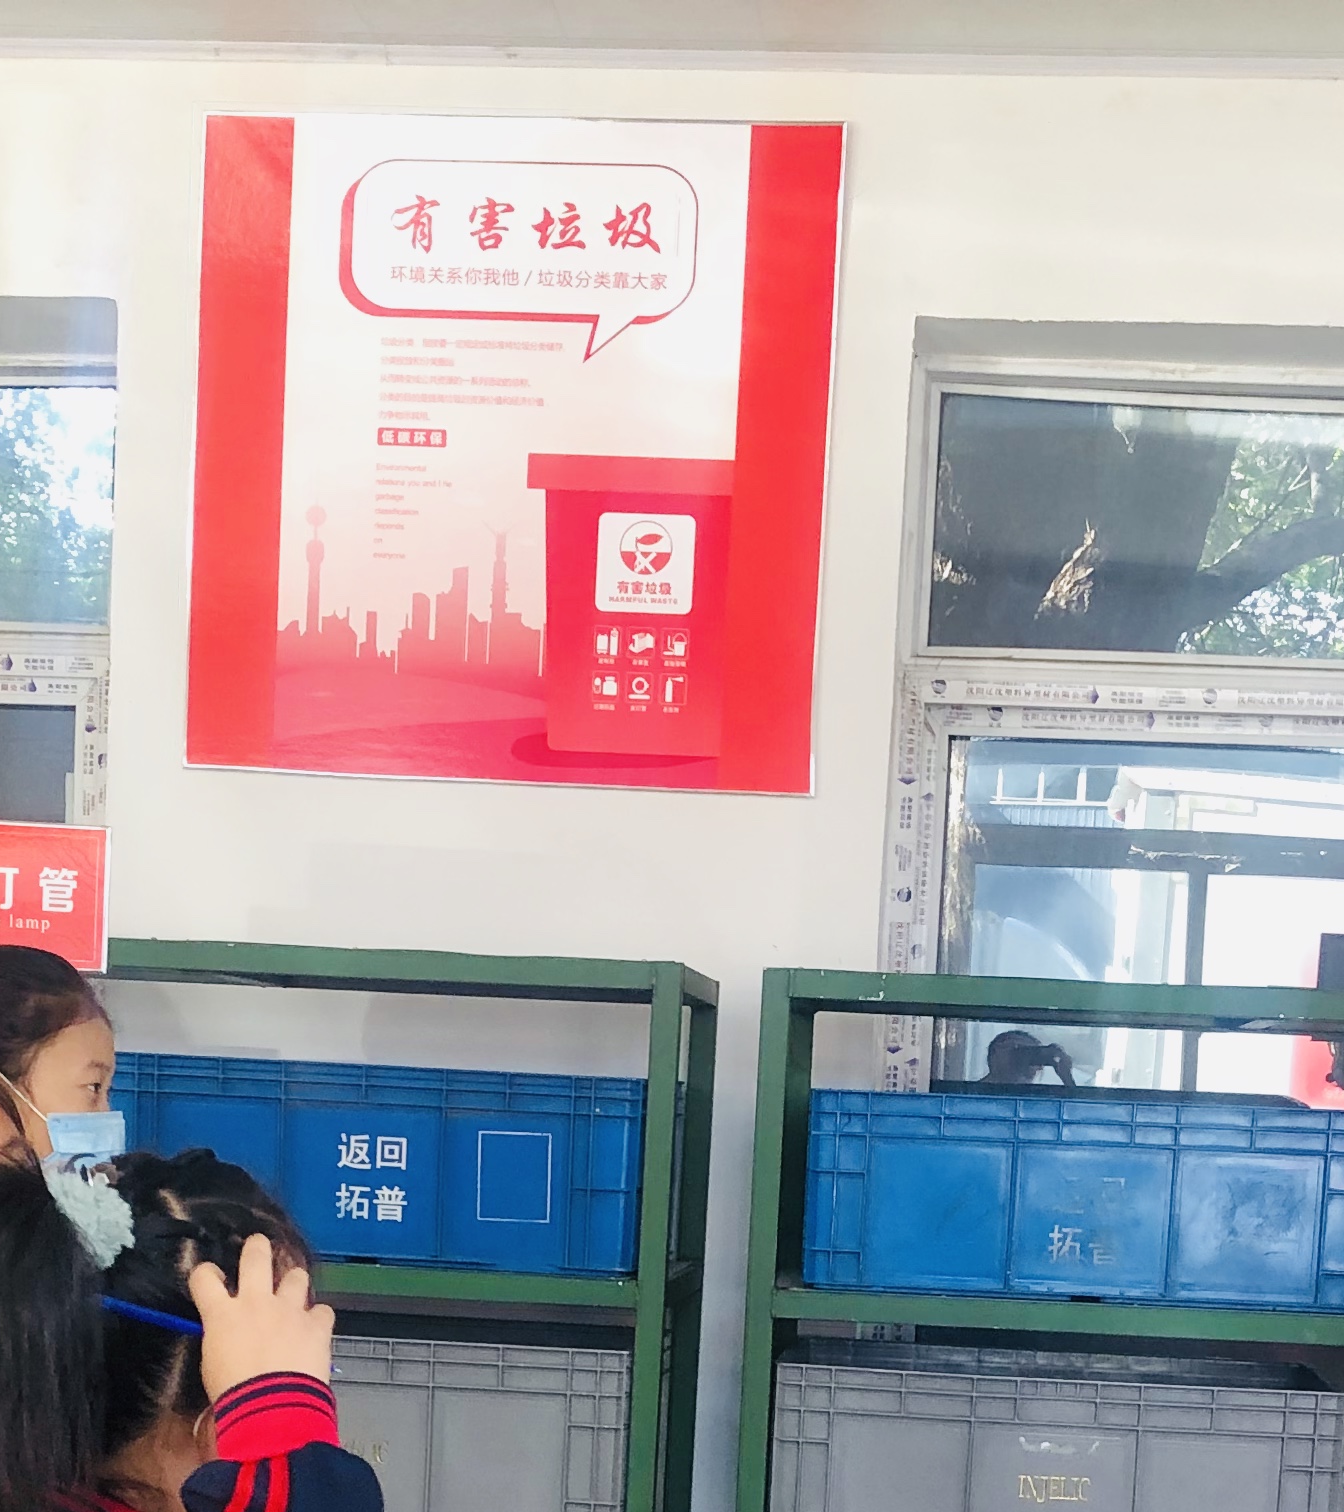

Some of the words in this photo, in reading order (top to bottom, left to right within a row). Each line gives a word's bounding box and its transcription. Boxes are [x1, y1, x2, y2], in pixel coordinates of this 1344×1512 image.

[391, 194, 662, 255] 有害垃圾
[617, 581, 672, 595] 有害垃圾
[9, 914, 51, 932] lamp
[337, 1132, 407, 1171] 返回
[336, 1184, 407, 1223] 拓普
